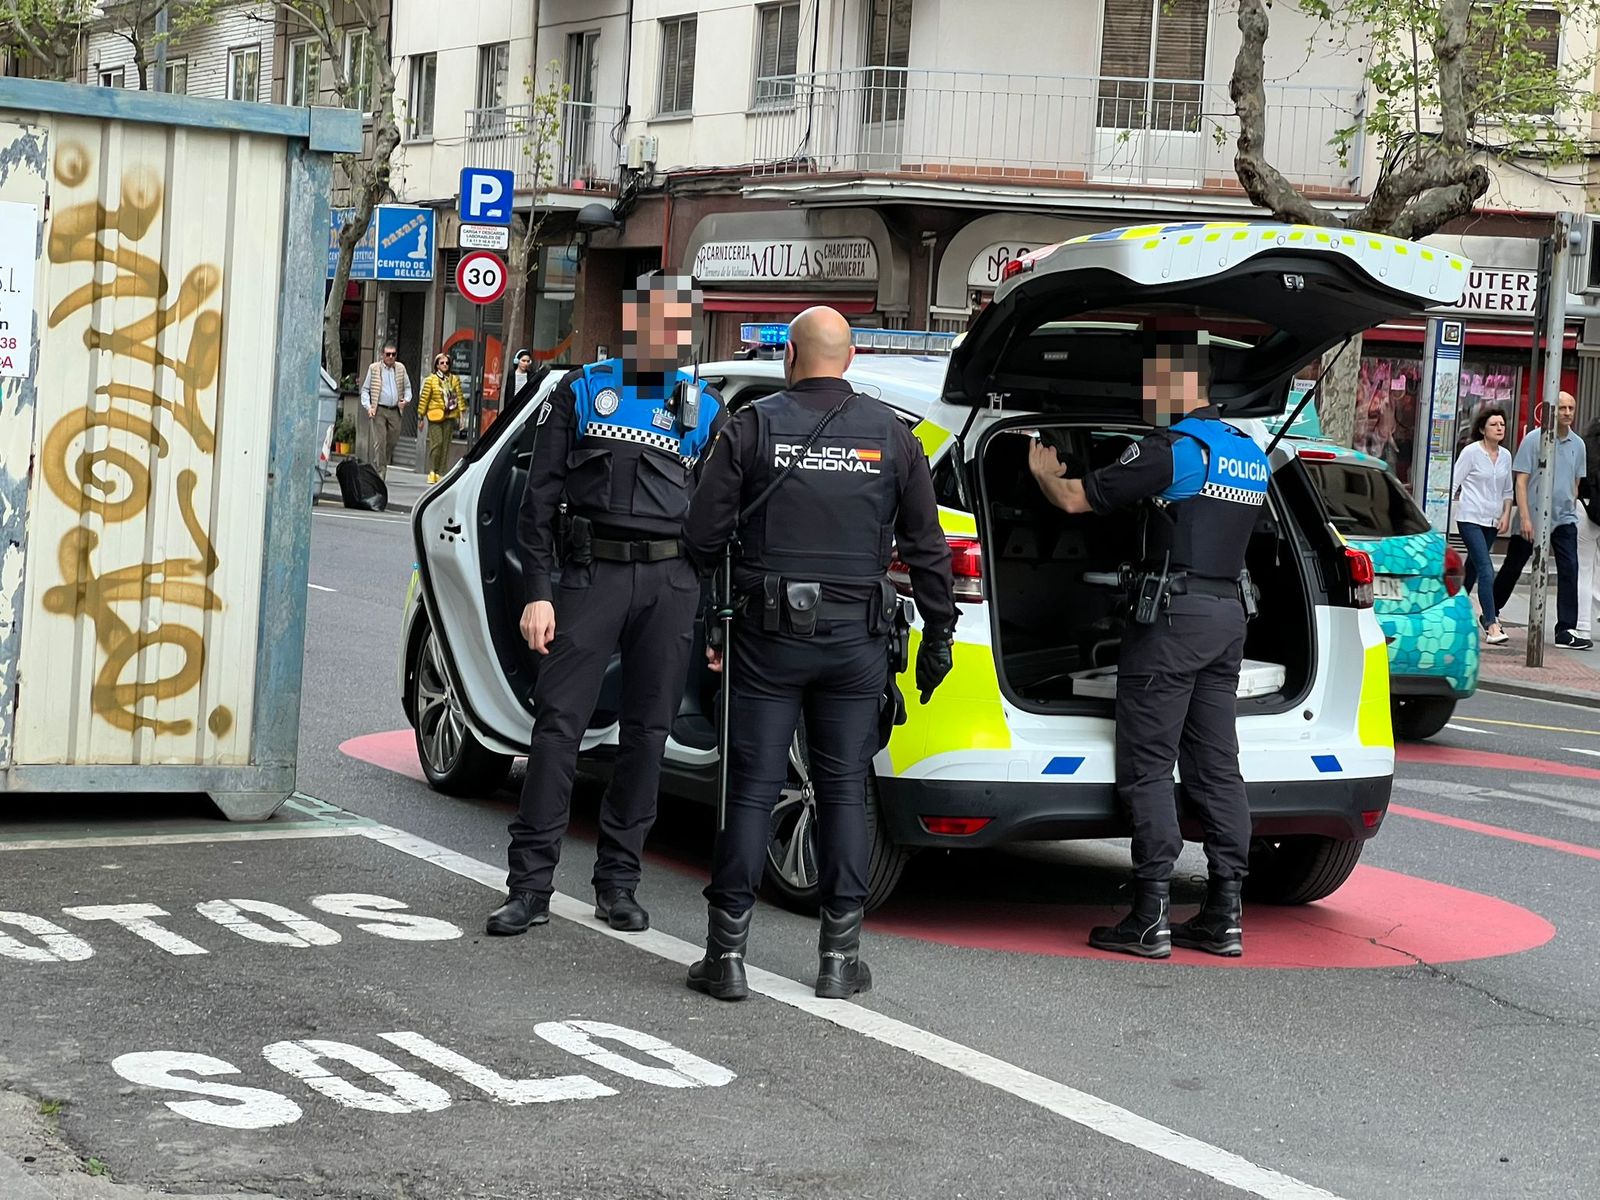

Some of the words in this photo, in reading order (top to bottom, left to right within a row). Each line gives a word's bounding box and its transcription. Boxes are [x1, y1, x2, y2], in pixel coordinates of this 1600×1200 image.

[470, 174, 503, 216] P
[706, 245, 750, 261] CARNICERIA
[823, 243, 871, 260] CHARCUTERIA
[378, 260, 412, 269] CENTRO
[413, 260, 424, 269] DE
[750, 244, 824, 278] MULAS
[826, 261, 865, 277] JAMONERIA
[394, 268, 431, 278] BELLEZA
[468, 268, 496, 286] 30
[1469, 272, 1538, 291] UTER
[1454, 292, 1536, 311] ONERI
[774, 443, 860, 460] POLICIA
[1218, 456, 1268, 482] POLICÍA
[111, 1019, 739, 1129] SOLO
